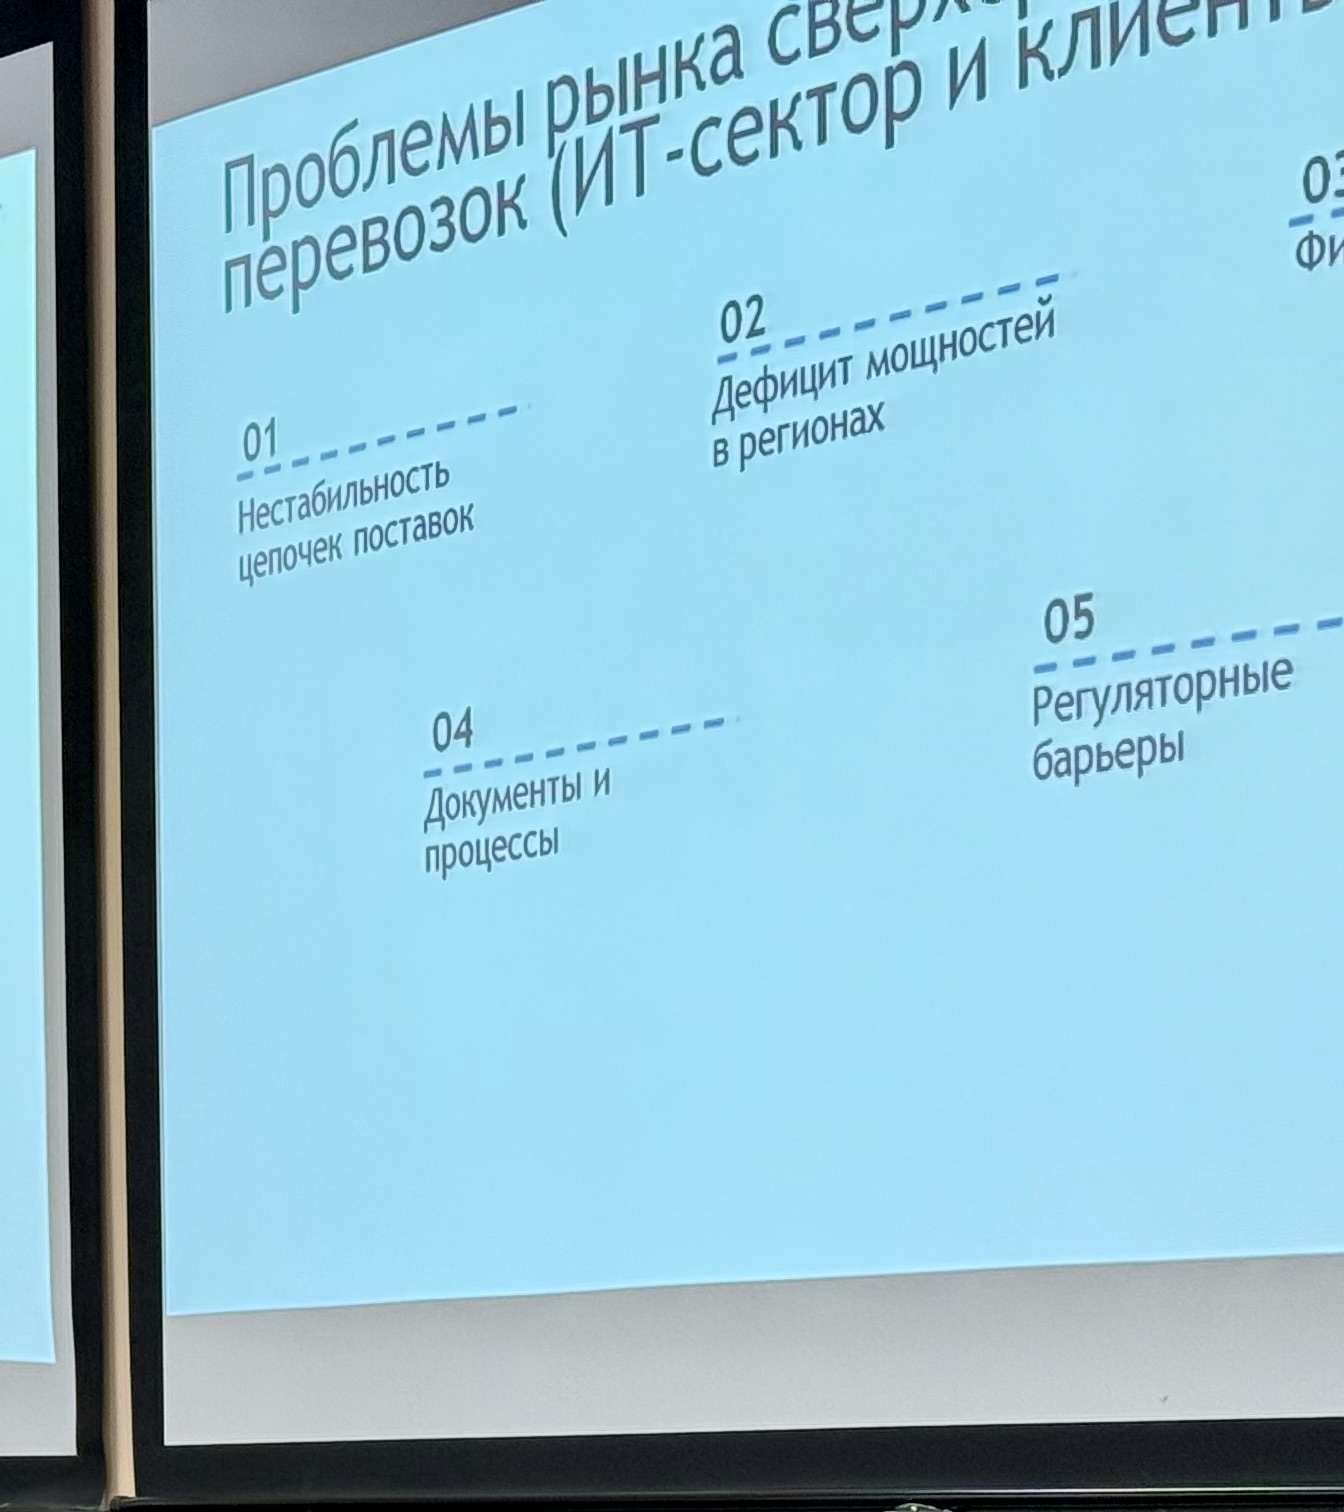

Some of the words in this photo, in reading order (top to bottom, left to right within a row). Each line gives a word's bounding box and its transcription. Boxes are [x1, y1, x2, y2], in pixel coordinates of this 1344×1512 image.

[225, 89, 524, 243] Проблемы
[547, 24, 744, 160] рынка
[768, 0, 1028, 65] свер
[225, 173, 528, 315] перевозок
[552, 60, 922, 238] (ИТ-сектор
[949, 36, 986, 111] и
[1018, 0, 1332, 89] клиен
[720, 294, 766, 343] 02
[711, 355, 853, 426] Дефицит
[866, 293, 1054, 380] мощностей
[244, 417, 275, 462] 01
[714, 438, 729, 468] в
[740, 401, 885, 473] регионах
[239, 461, 450, 534] Нестабильность
[240, 533, 342, 587] цепочек
[354, 503, 474, 556] поставок
[1044, 592, 1094, 645] 05
[1034, 658, 1294, 728] Регуляторные
[433, 706, 473, 753] 04
[1033, 730, 1184, 787] барьеры
[424, 772, 581, 834] Документы
[594, 768, 610, 797] и
[426, 827, 558, 881] процессы
